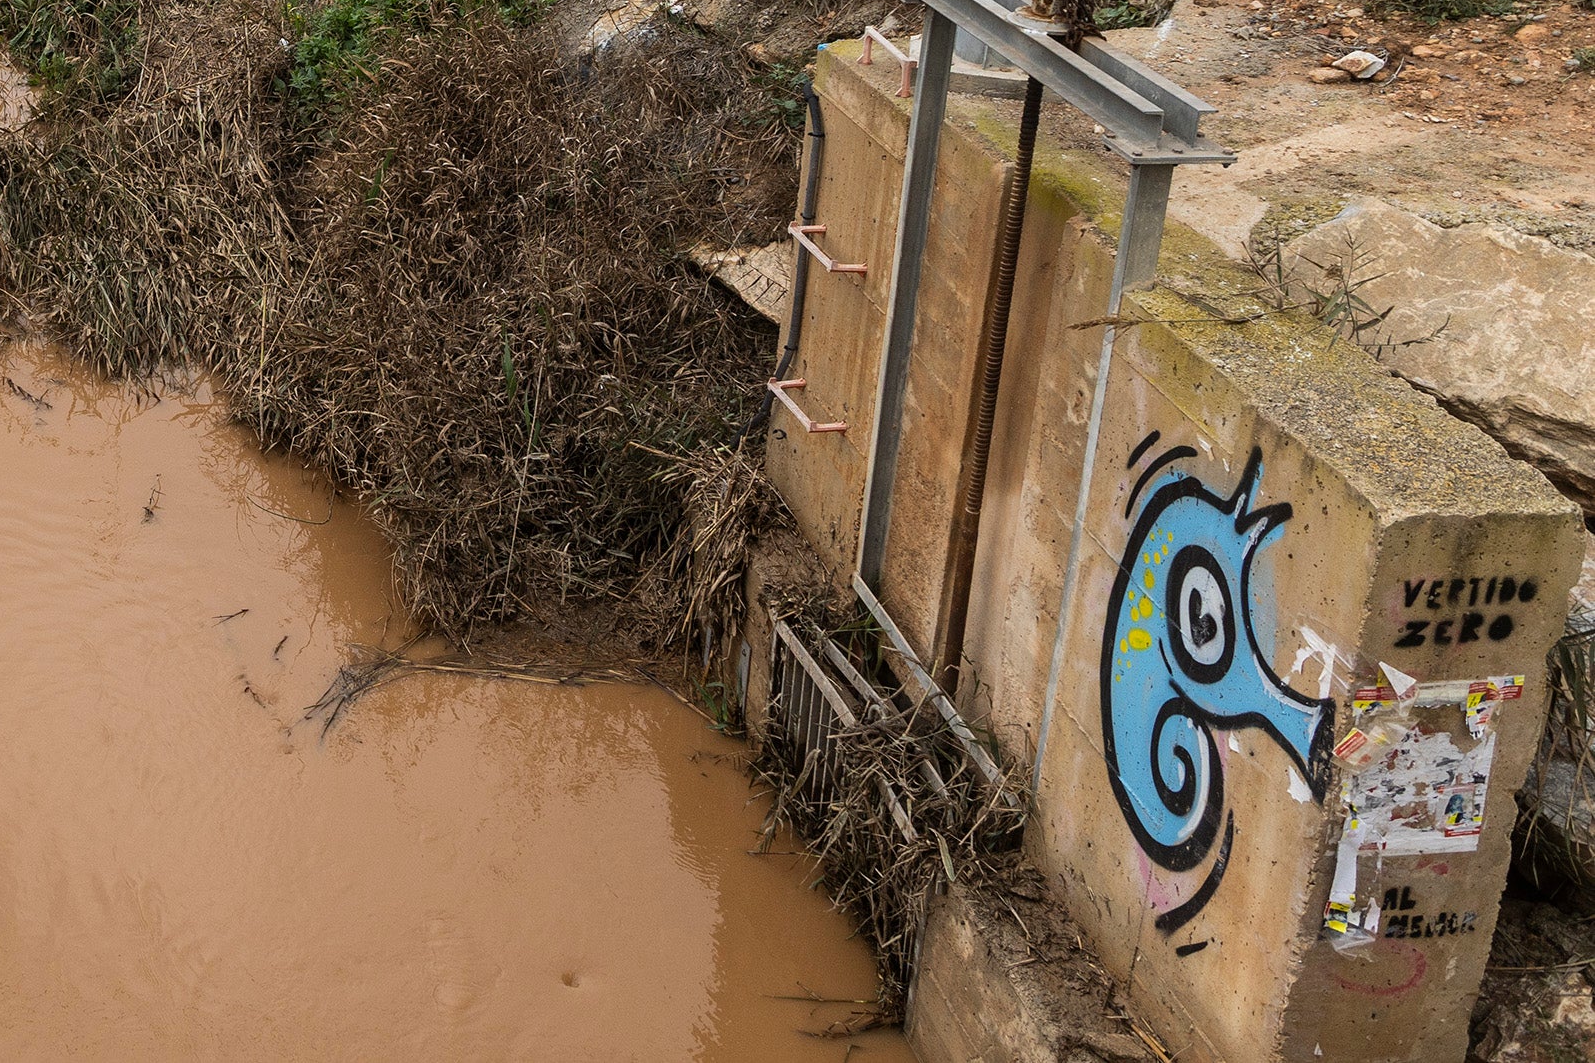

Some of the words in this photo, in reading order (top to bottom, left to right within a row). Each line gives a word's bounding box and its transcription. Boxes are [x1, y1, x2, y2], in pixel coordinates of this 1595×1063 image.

[1404, 575, 1539, 610] VERTIDO
[1393, 611, 1515, 648] ZERO
[1381, 886, 1417, 912] AL
